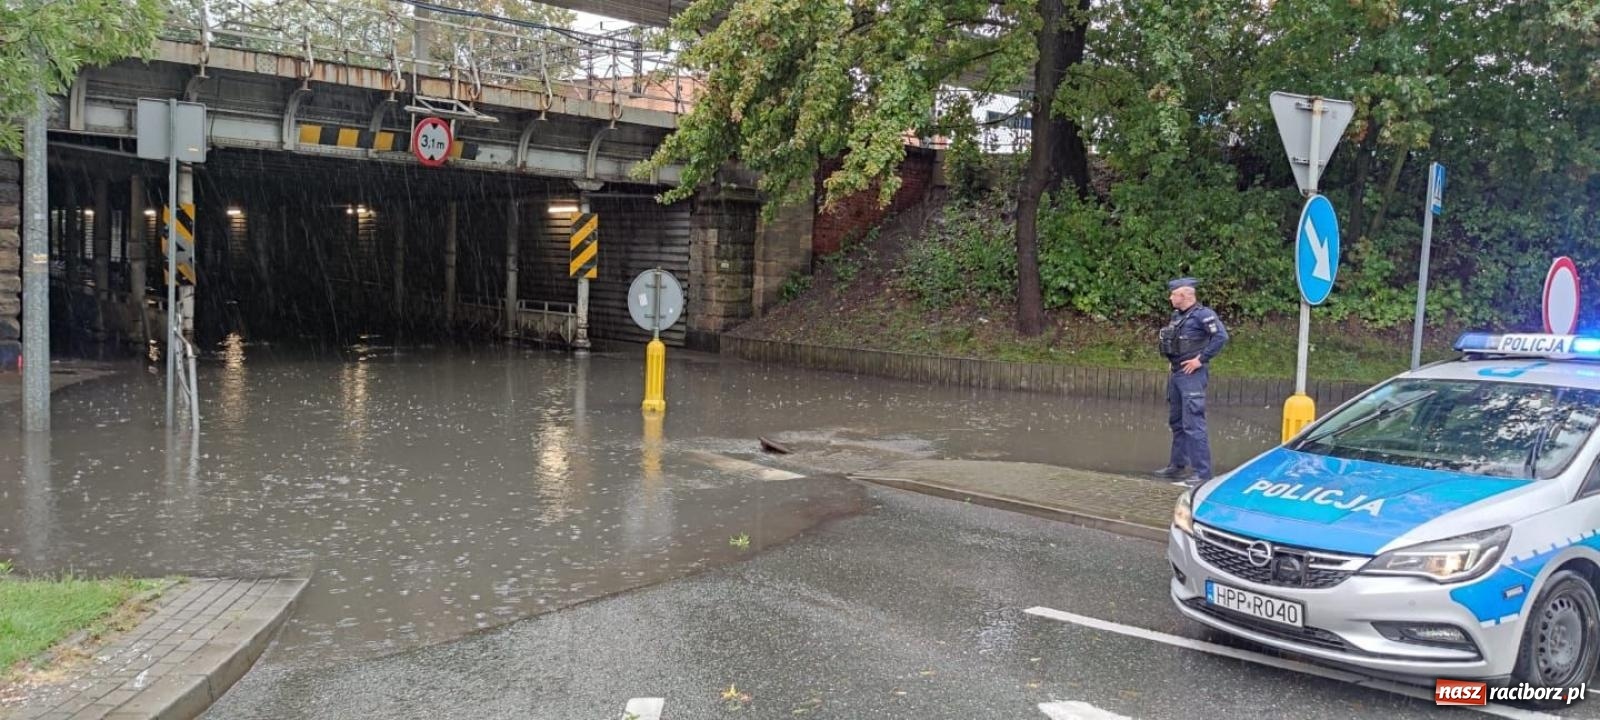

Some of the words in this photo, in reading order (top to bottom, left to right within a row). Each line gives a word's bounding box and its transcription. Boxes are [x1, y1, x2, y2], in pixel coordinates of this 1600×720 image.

[1501, 337, 1564, 353] POLICJA
[1242, 479, 1386, 517] POLICJA
[1217, 586, 1246, 610] HPP
[1253, 596, 1298, 624] R040
